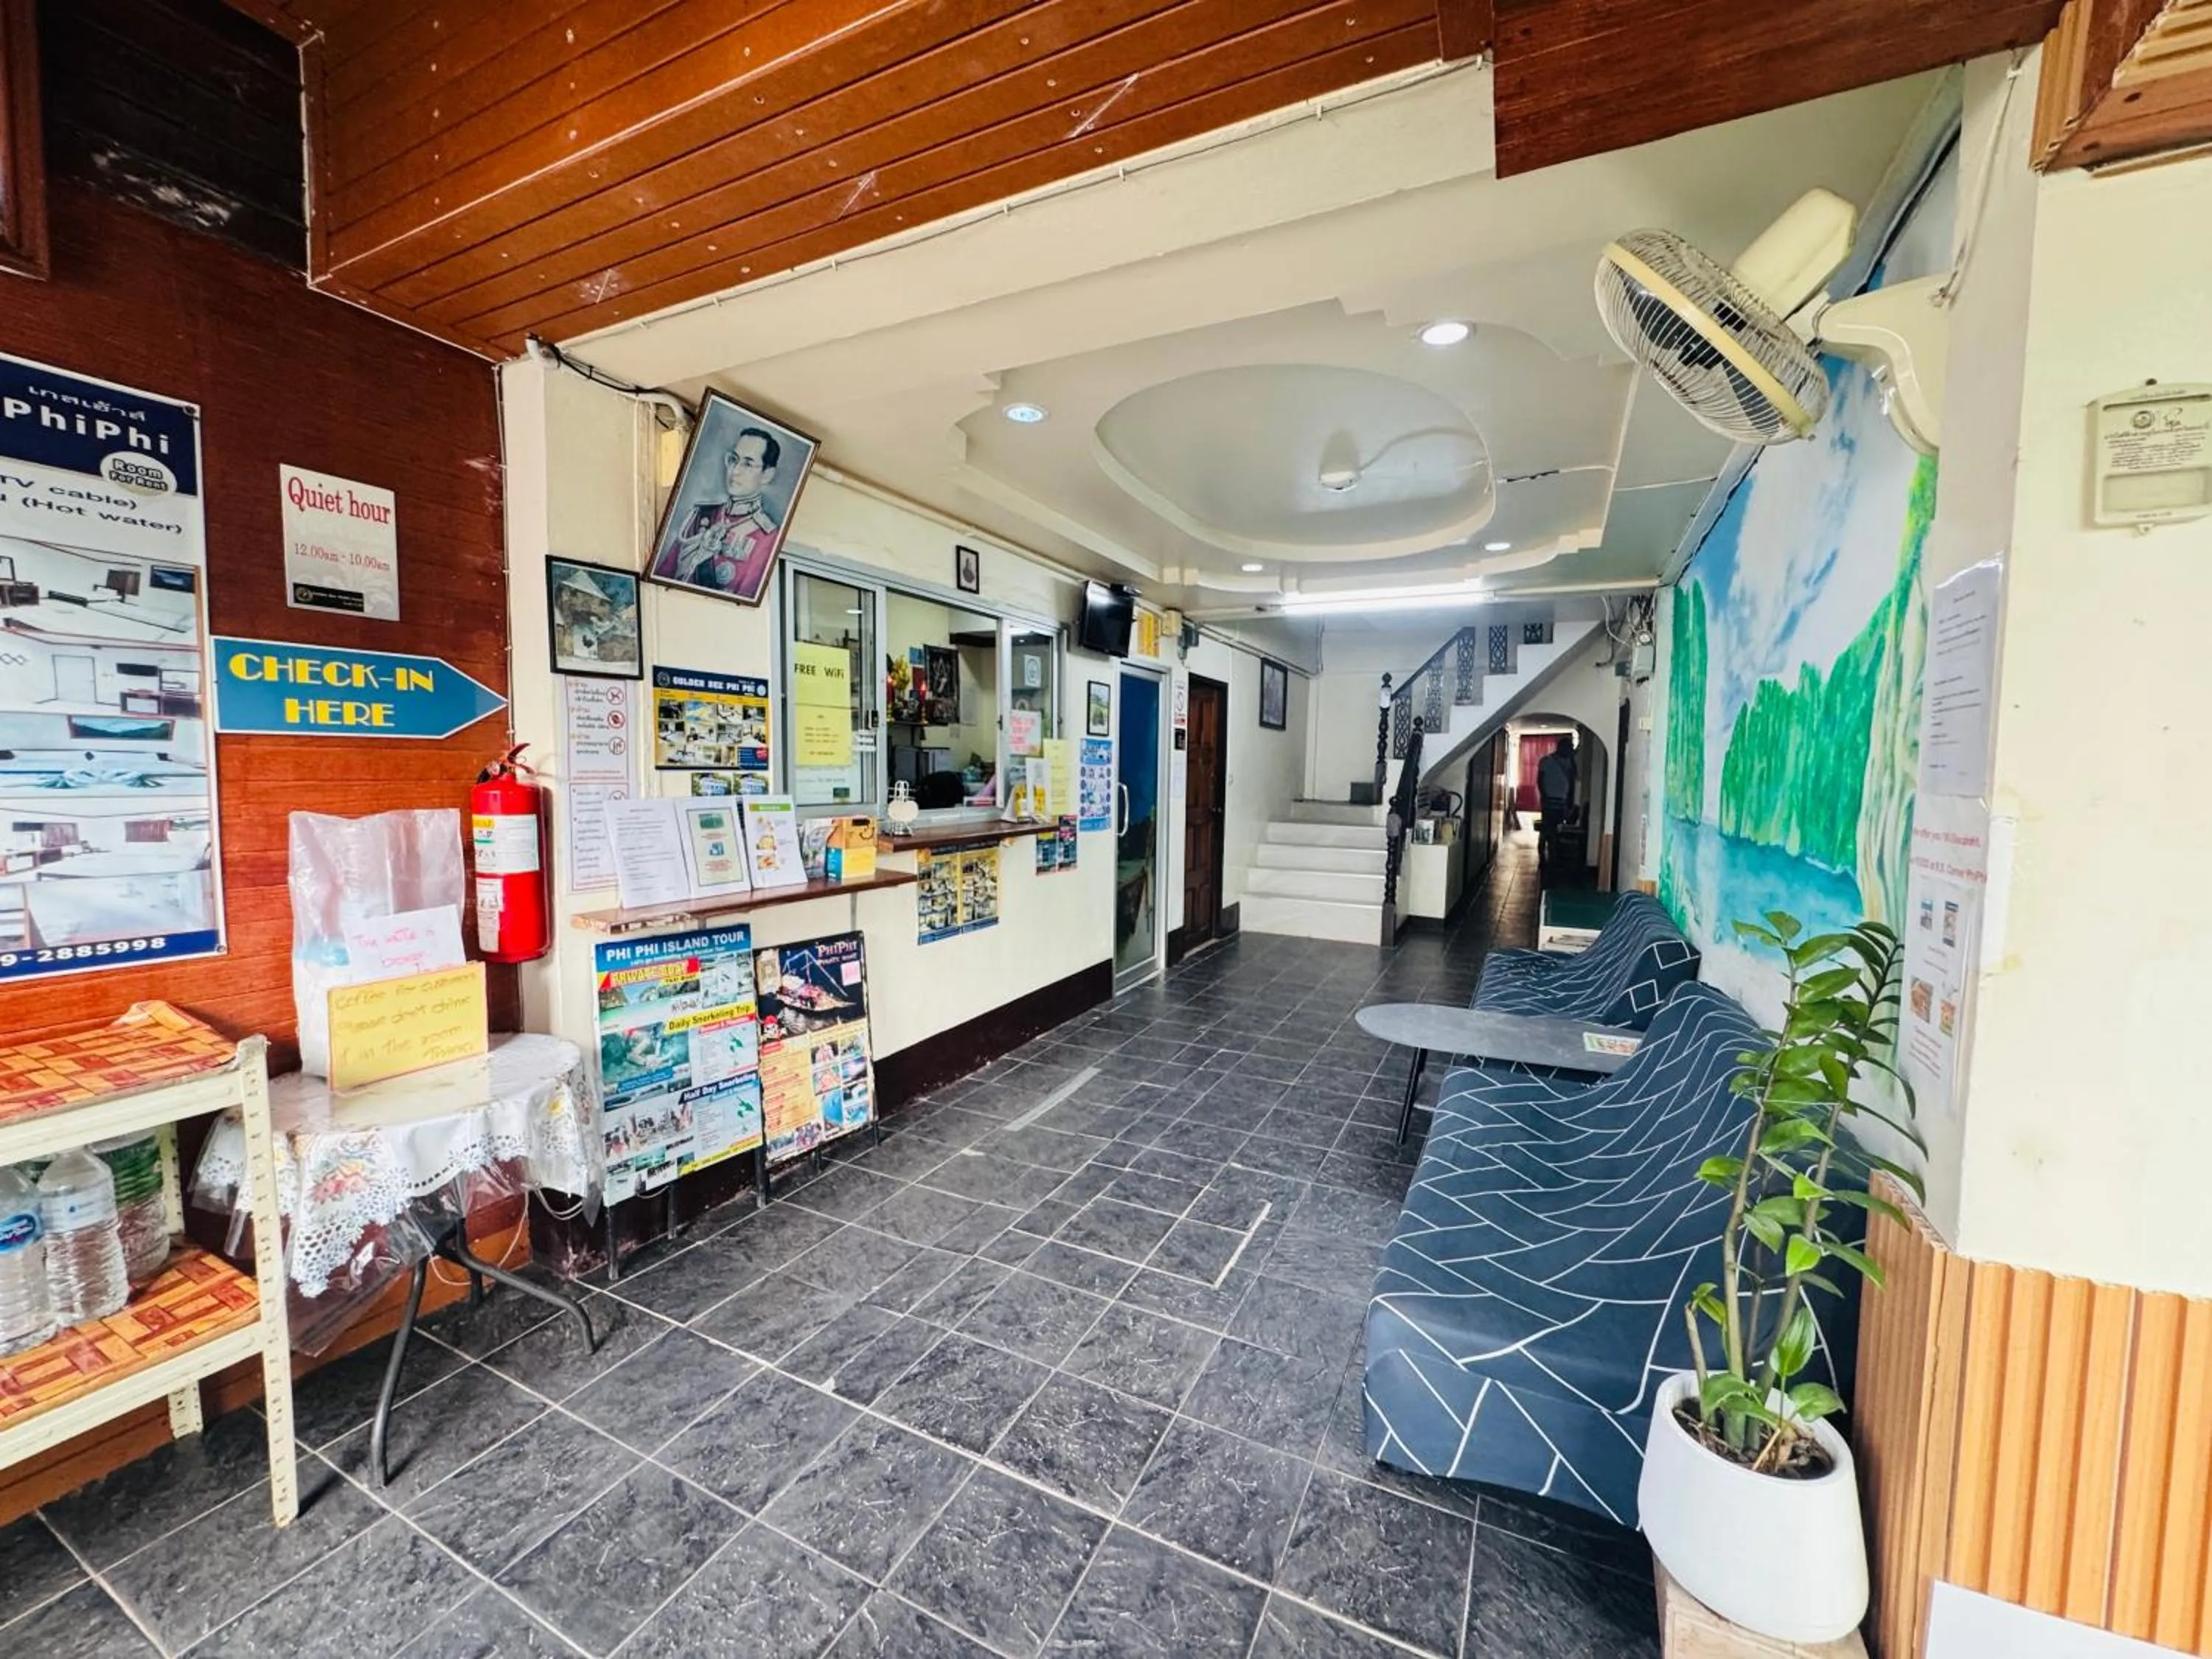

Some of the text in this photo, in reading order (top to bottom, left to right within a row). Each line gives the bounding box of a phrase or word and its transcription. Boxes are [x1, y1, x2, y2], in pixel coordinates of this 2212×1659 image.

[3, 397, 169, 454] PhiPhi
[109, 470, 168, 492] For Rent
[113, 458, 163, 479] Room
[49, 486, 137, 509] cable)
[288, 476, 391, 524] Quiet hour
[21, 497, 87, 516] (Hot
[99, 512, 182, 534] water)
[229, 653, 434, 692] CHECK-IN
[794, 664, 844, 678] FREE WiFi
[285, 698, 395, 726] HERE
[606, 947, 631, 961] PHI
[636, 944, 658, 959] PHI
[663, 935, 709, 953] ISLAND
[712, 931, 744, 945] TOUR
[669, 1018, 690, 1030] Daily
